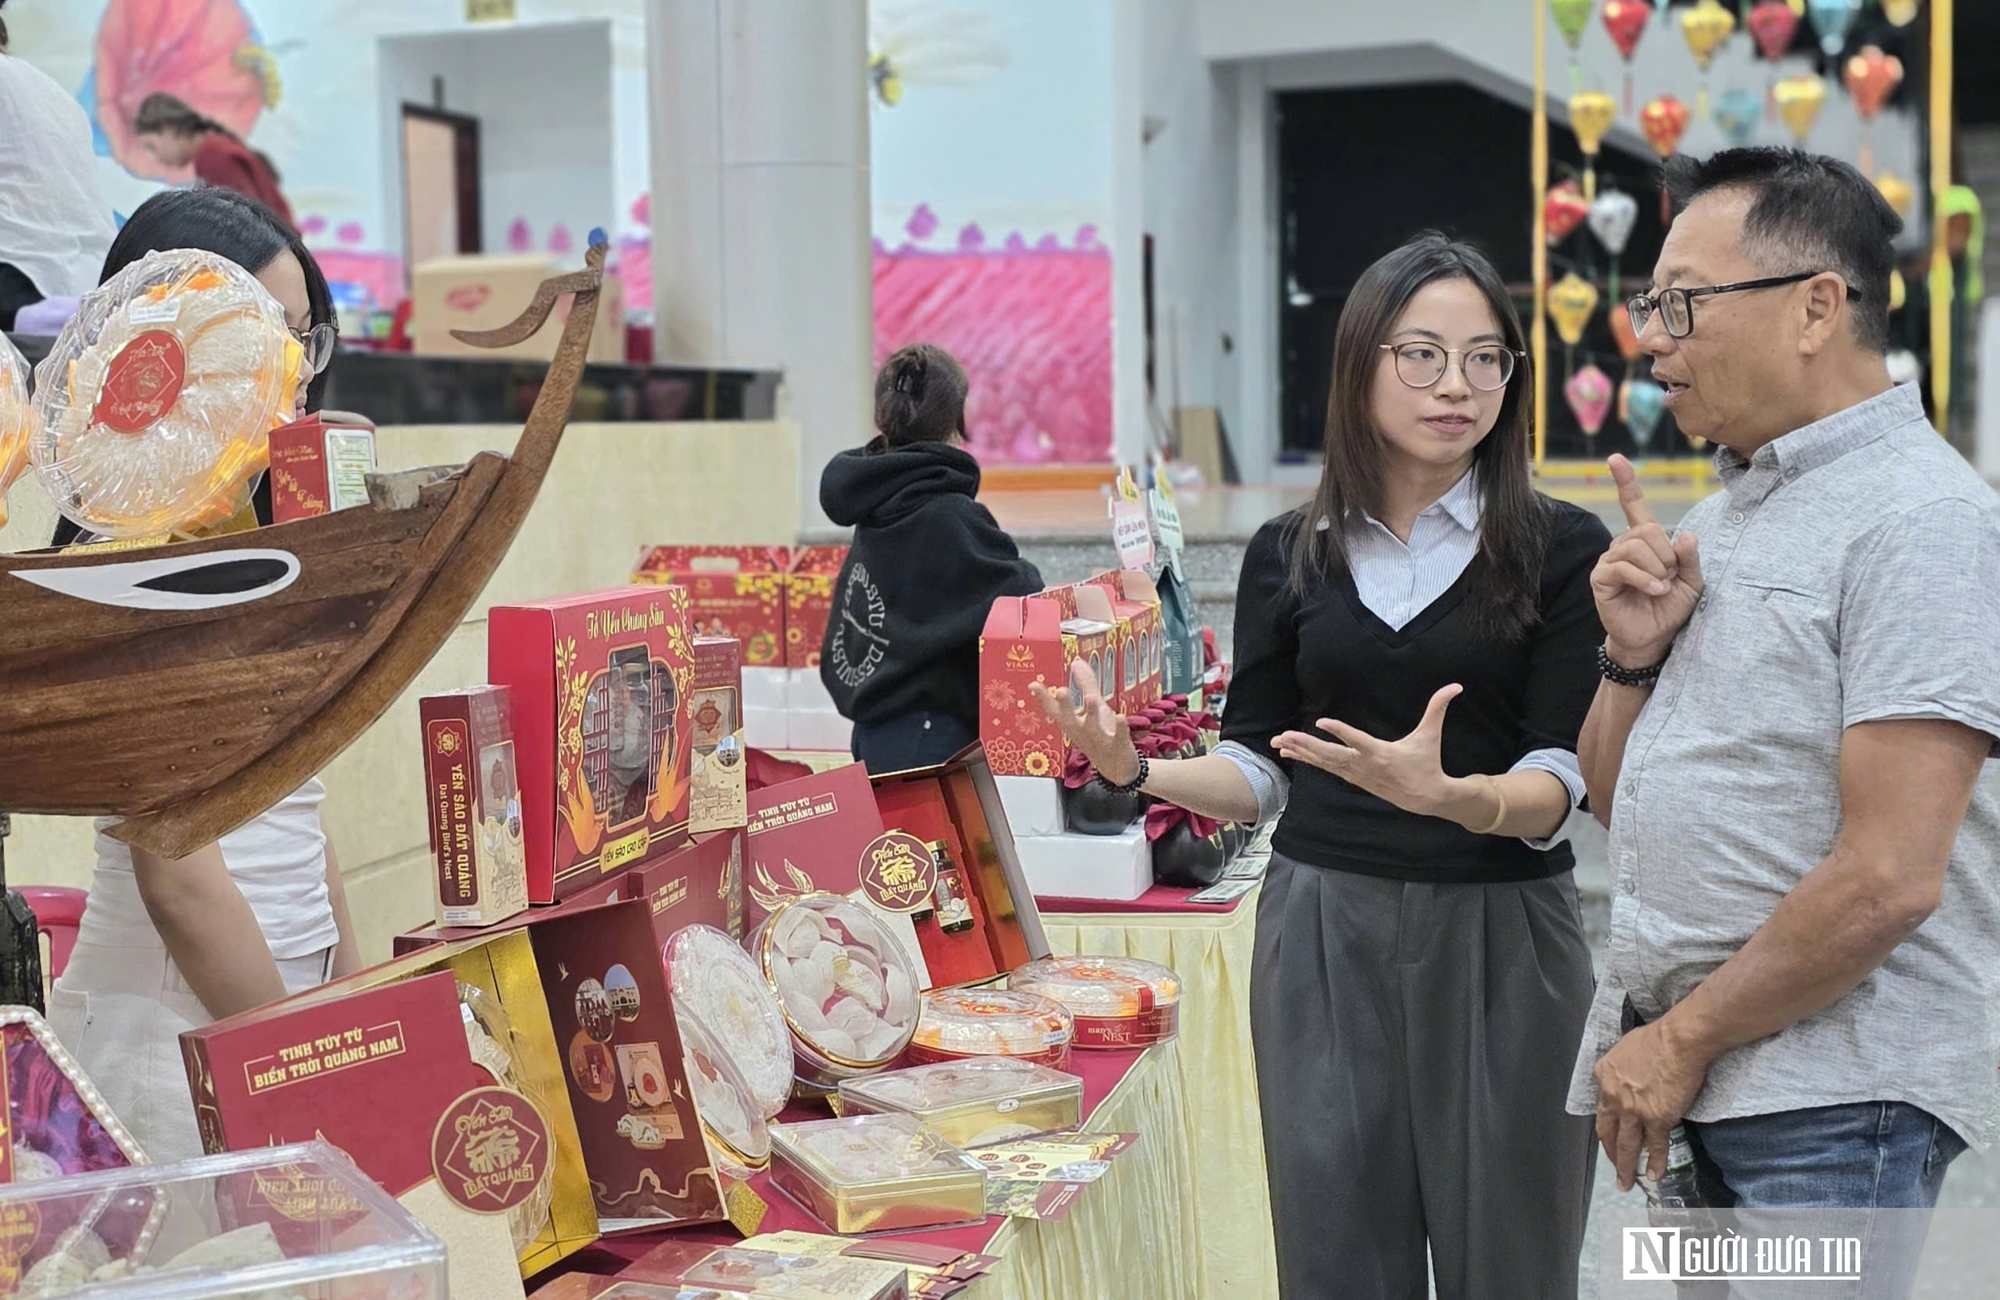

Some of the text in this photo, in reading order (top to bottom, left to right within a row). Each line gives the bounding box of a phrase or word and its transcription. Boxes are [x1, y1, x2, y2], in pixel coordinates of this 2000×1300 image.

[1006, 661, 1036, 669] VIANA
[758, 805, 780, 819] TINH
[786, 808, 814, 822] QUẢNG
[814, 802, 834, 814] NAM
[451, 763, 472, 899] YẾN SÀO ĐẤT QUẢNG
[1102, 1032, 1131, 1042] NEST
[279, 1042, 313, 1062] TINH
[324, 1047, 367, 1068] QUẢNG
[369, 1036, 399, 1056] NAM
